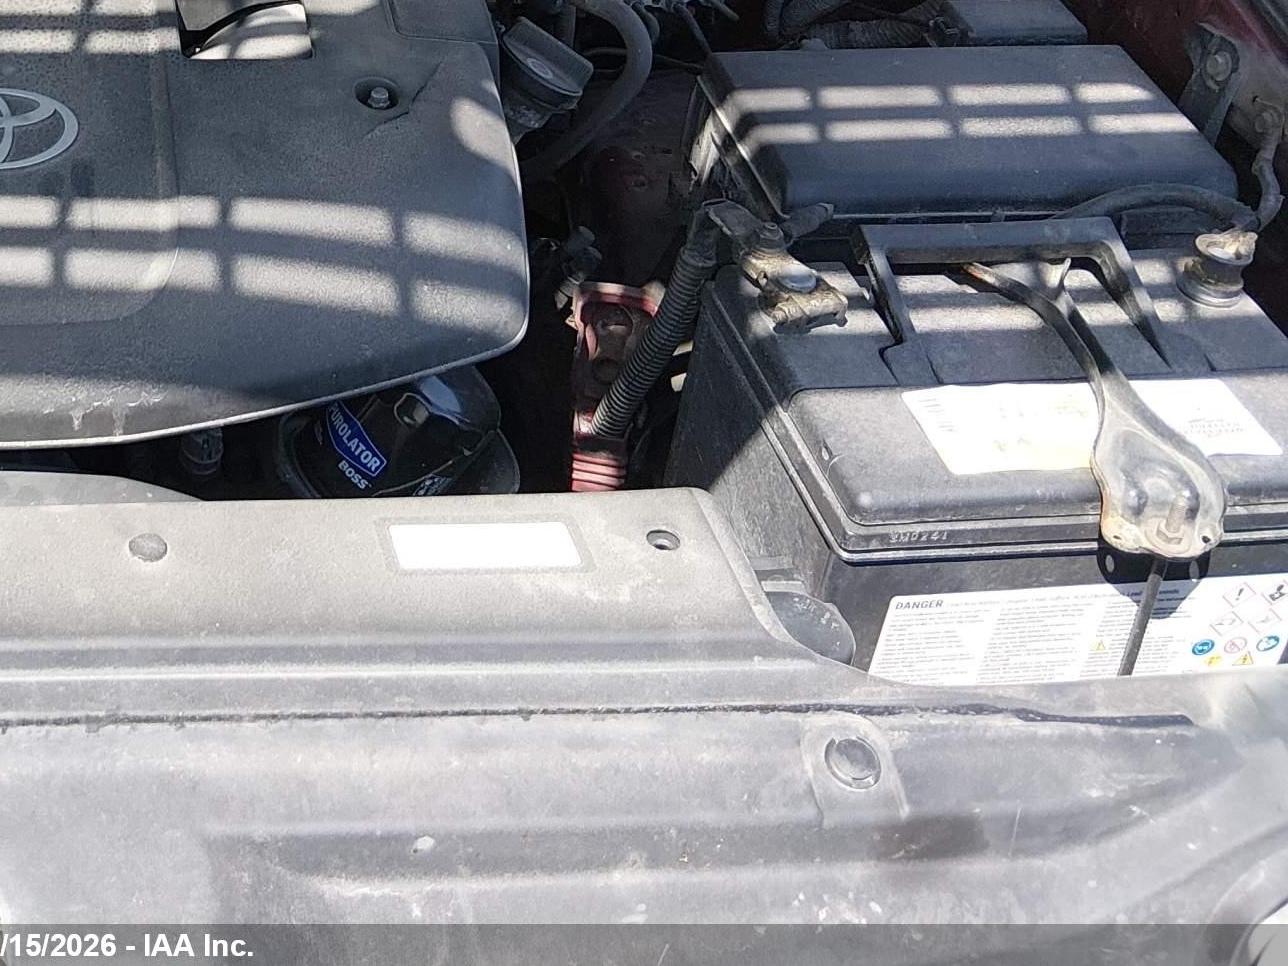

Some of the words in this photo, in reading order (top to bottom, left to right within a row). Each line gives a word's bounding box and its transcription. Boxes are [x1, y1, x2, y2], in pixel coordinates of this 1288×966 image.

[328, 401, 381, 472] PUROLATOR
[337, 459, 369, 489] BOSS
[895, 599, 944, 610] DANGER
